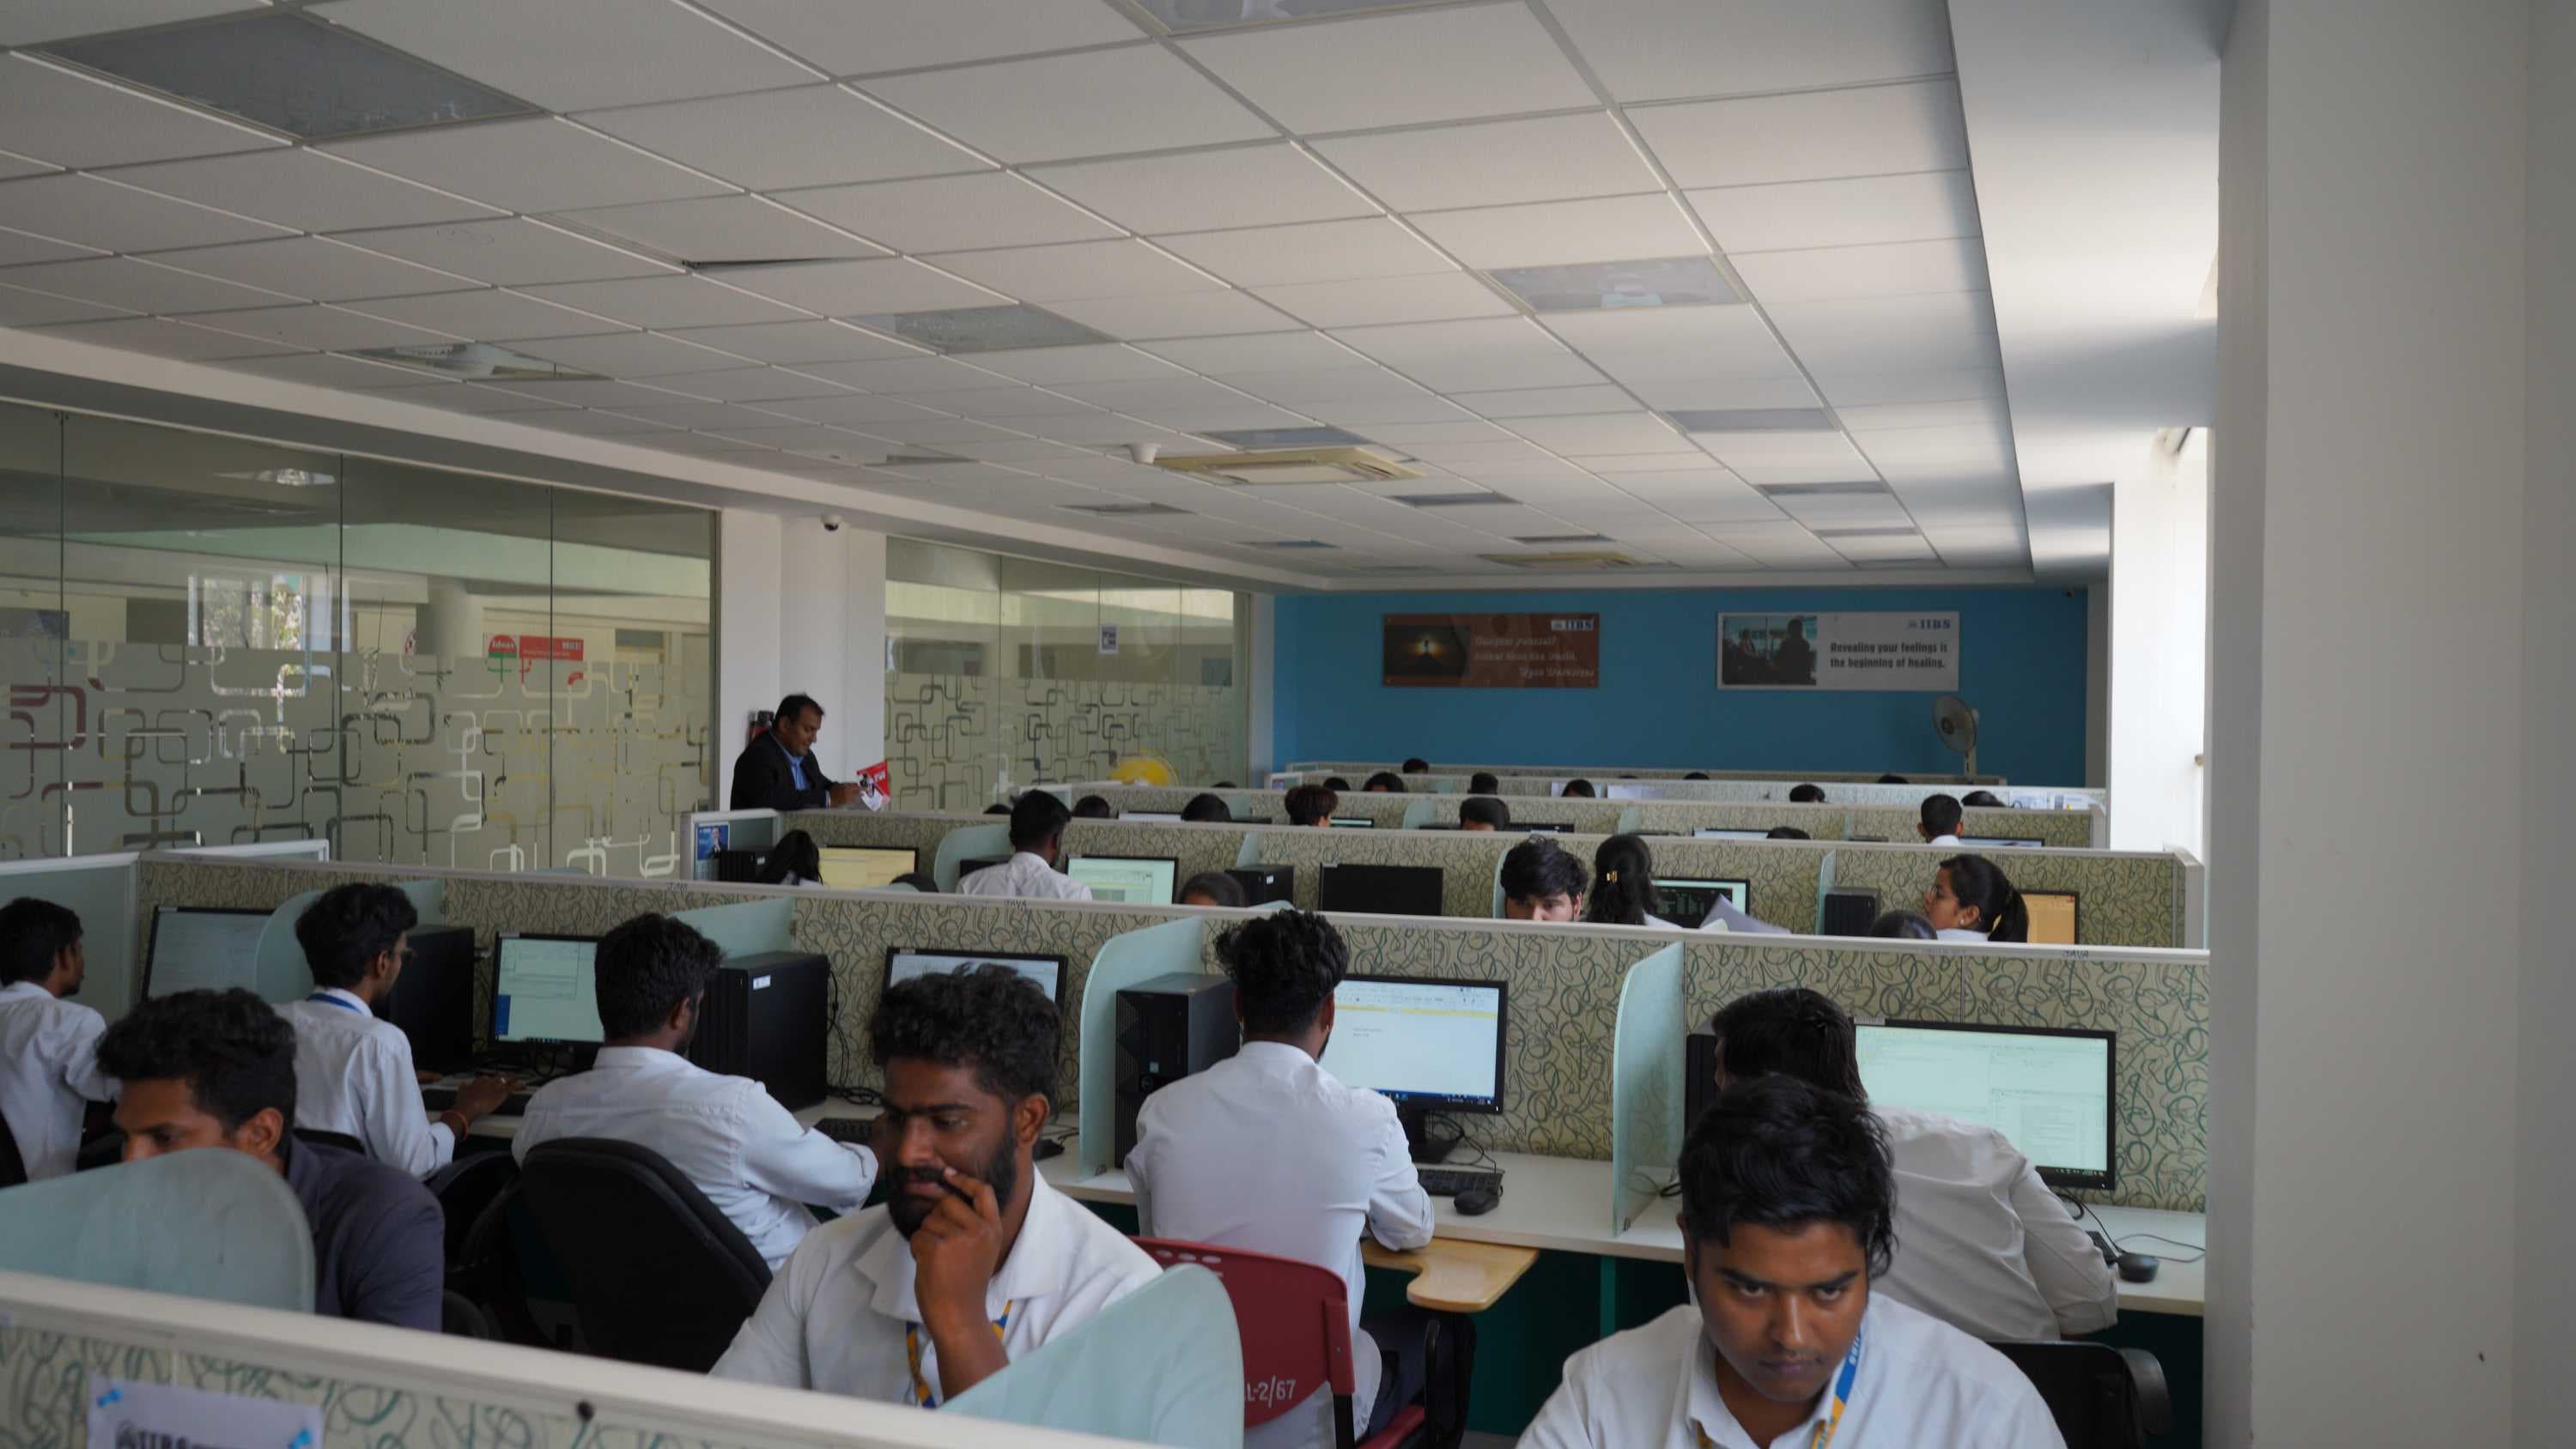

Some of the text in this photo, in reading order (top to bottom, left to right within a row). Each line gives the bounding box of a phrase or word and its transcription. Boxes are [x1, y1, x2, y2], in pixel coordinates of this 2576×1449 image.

[1830, 642, 1947, 653] Revealing your feelings is
[1830, 658, 1945, 669] the beginning of healing.
